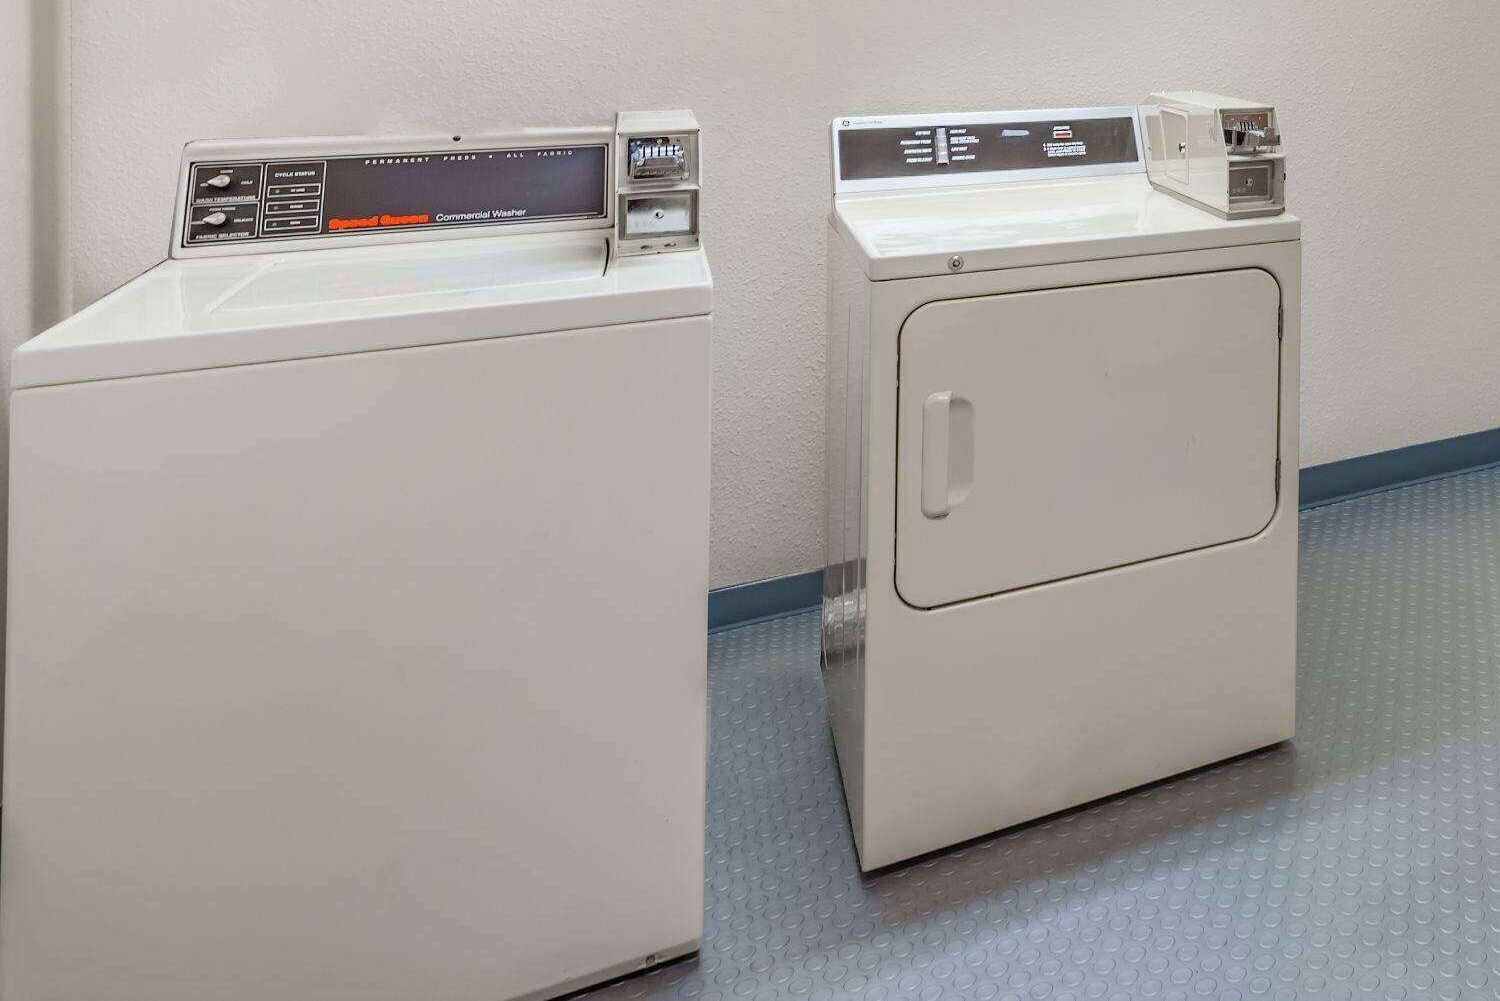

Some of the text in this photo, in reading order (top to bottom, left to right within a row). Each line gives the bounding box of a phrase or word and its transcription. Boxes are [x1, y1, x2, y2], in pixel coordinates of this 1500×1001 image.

[365, 157, 430, 166] PERMANENT
[435, 208, 527, 223] Commercial Washer
